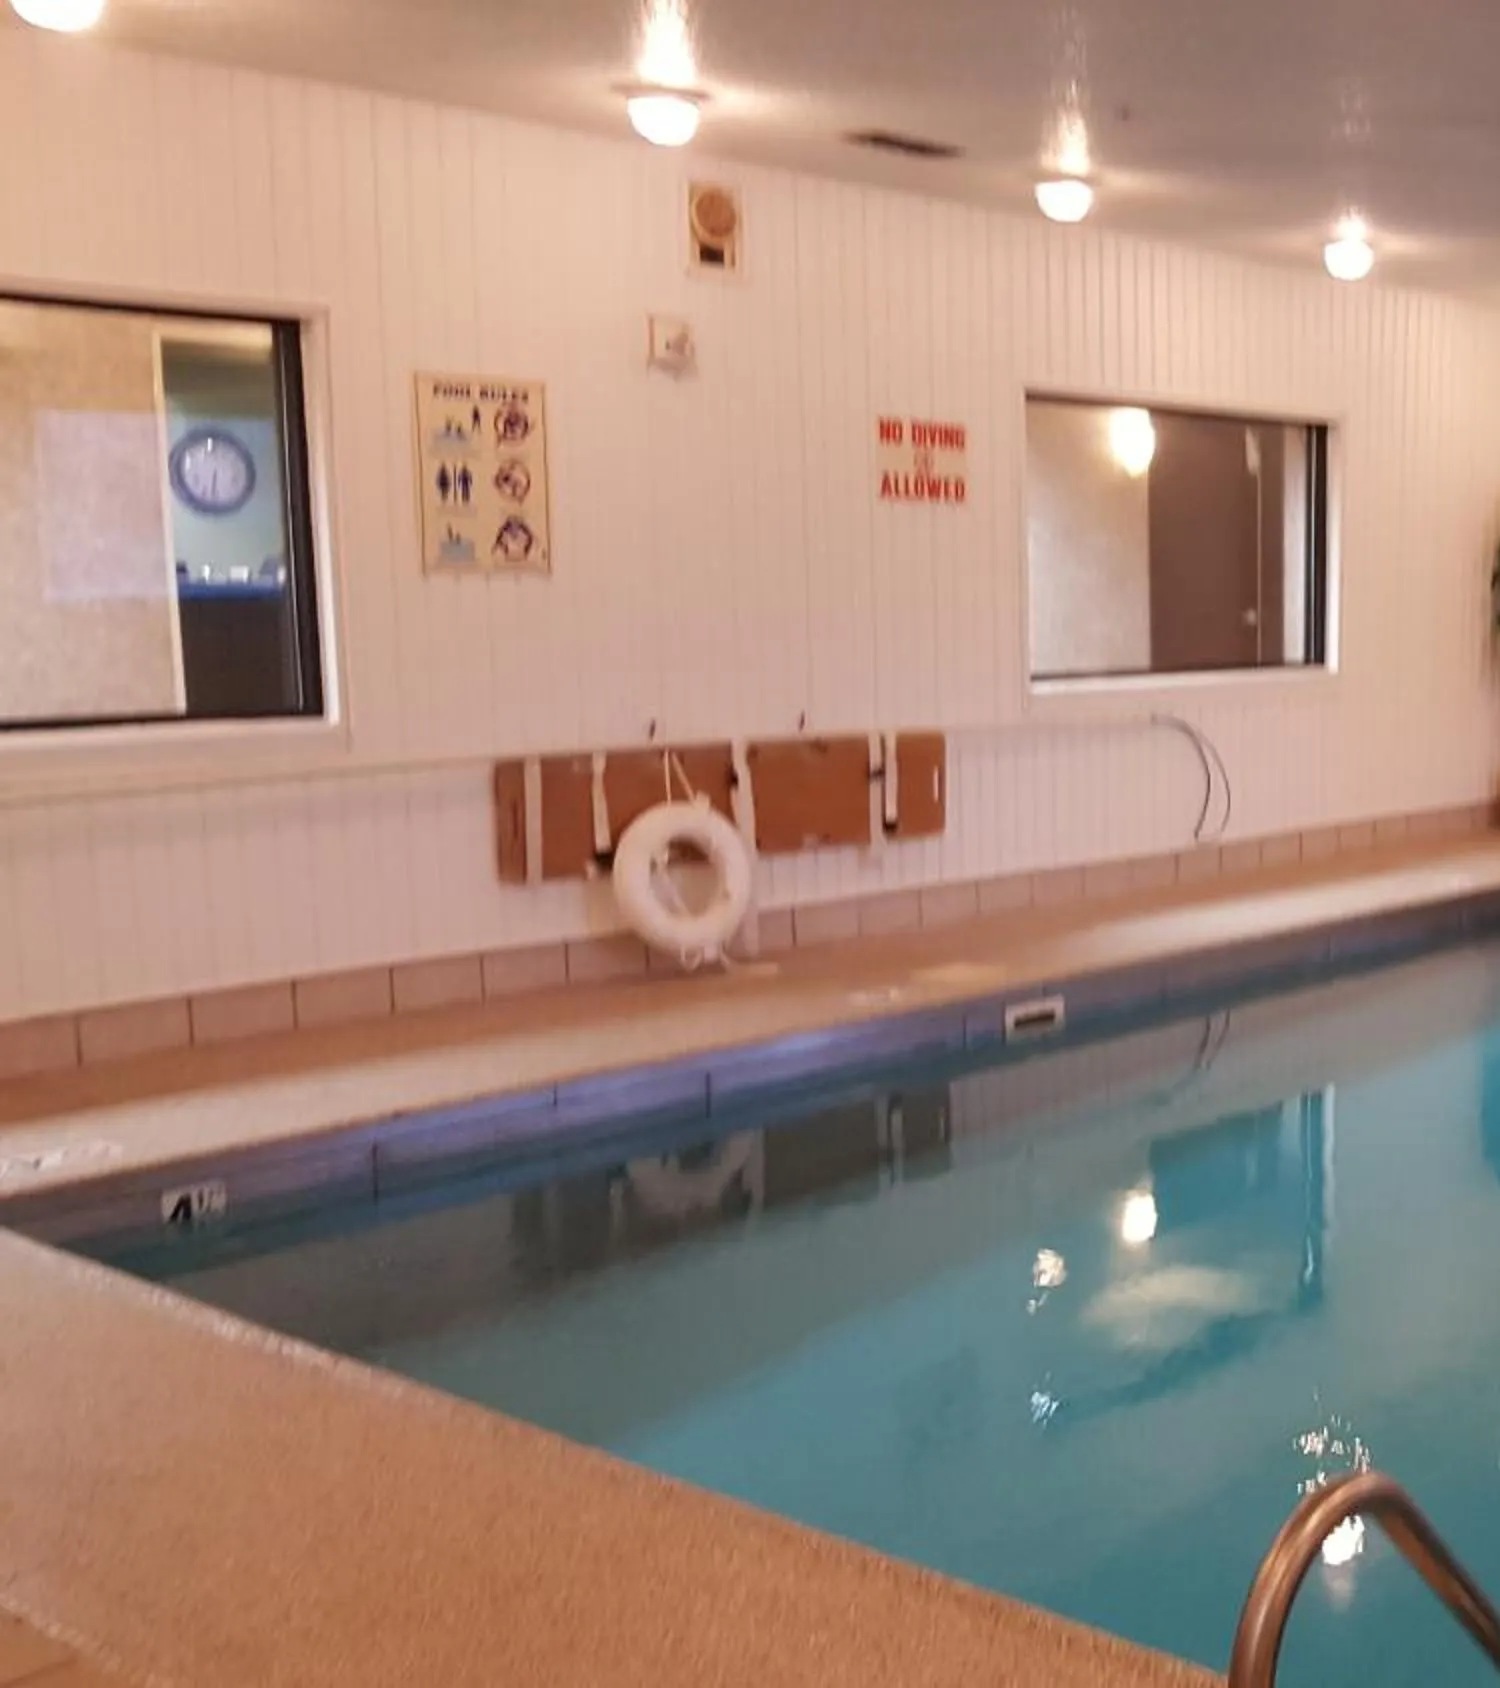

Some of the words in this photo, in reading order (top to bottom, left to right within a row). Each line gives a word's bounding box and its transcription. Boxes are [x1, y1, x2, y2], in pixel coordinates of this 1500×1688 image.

[878, 417, 903, 444] NO
[911, 421, 965, 450] DIVING
[880, 470, 965, 502] ALLOWED
